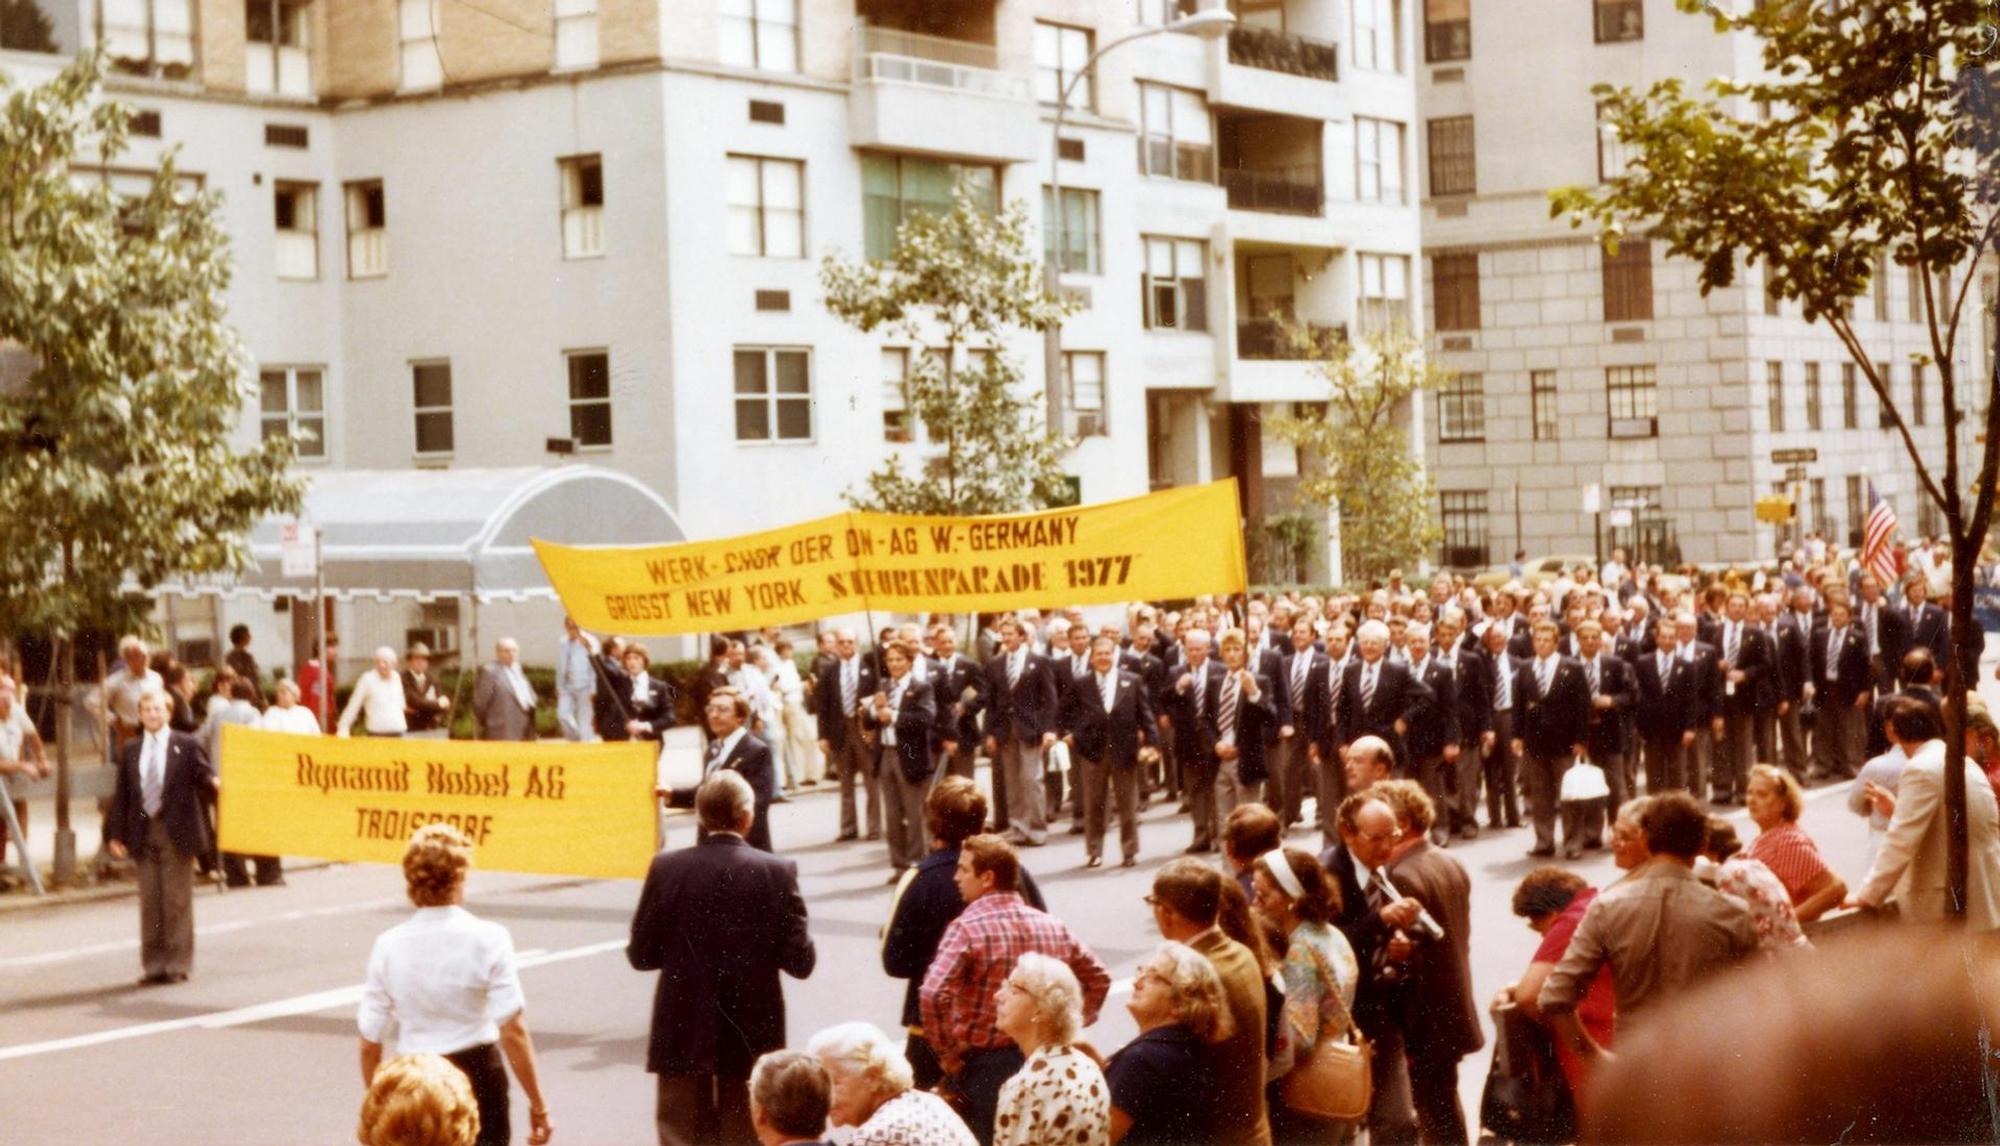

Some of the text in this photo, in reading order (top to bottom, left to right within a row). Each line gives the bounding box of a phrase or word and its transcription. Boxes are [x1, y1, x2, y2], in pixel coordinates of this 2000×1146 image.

[790, 535, 834, 566] DER
[685, 587, 732, 618] NEW
[744, 579, 807, 611] YORK
[827, 562, 1047, 598] STEUBENPARADE
[1063, 555, 1132, 588] 1977
[296, 753, 565, 800] Dynamit Nobel AG
